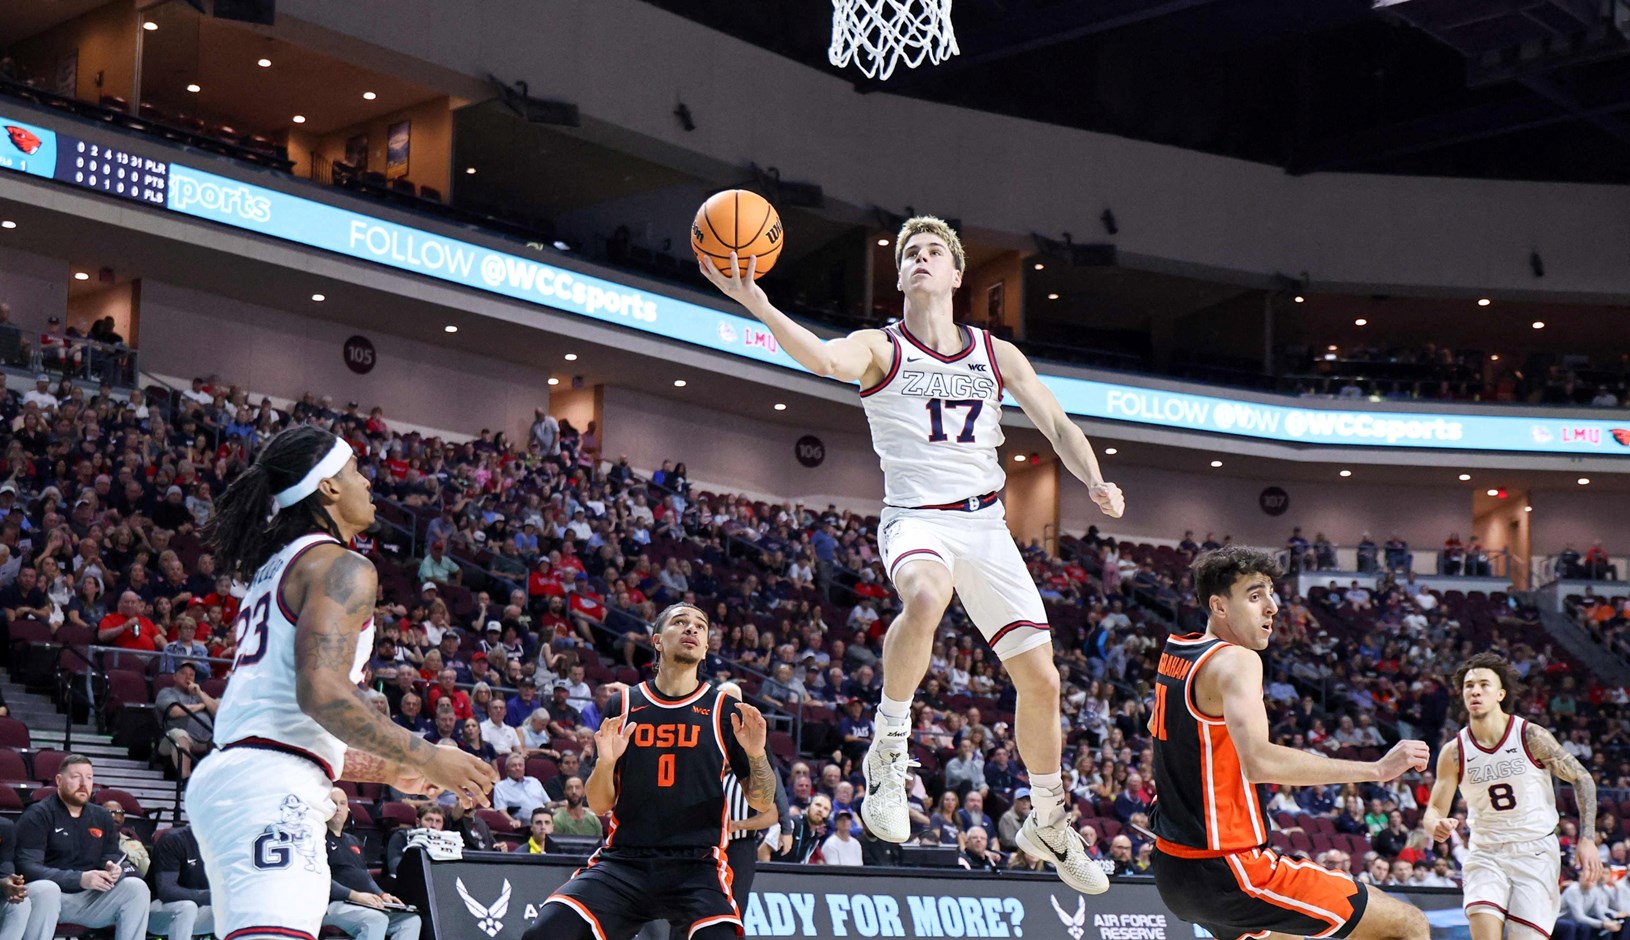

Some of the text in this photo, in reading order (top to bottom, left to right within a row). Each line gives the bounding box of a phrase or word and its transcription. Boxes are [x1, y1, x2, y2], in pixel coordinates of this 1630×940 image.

[76, 156, 165, 189] 0 0 0 0 0 PTS
[77, 141, 166, 175] 0 2 4 13 31 PLR
[75, 171, 164, 203] 0 0 1 0 0 FLS
[350, 220, 657, 323] FOLLOW @WCCsports
[348, 346, 372, 365] 105
[744, 329, 777, 353] LMU
[901, 371, 994, 400] ZAGS
[926, 398, 984, 443] 17
[1106, 390, 1209, 425] FOLLOW
[1285, 411, 1463, 443] @WCCsports
[1563, 428, 1600, 444] LMU
[800, 445, 822, 459] 106
[634, 723, 700, 748] OSU
[657, 754, 675, 787] 0
[1467, 758, 1526, 784] ZAGS
[1488, 783, 1517, 811] 8
[252, 831, 293, 872] G
[825, 894, 906, 937] FOR
[906, 896, 1025, 938] MORE?
[1094, 914, 1167, 928] AIR FORCE
[1101, 927, 1166, 940] RESERVE
